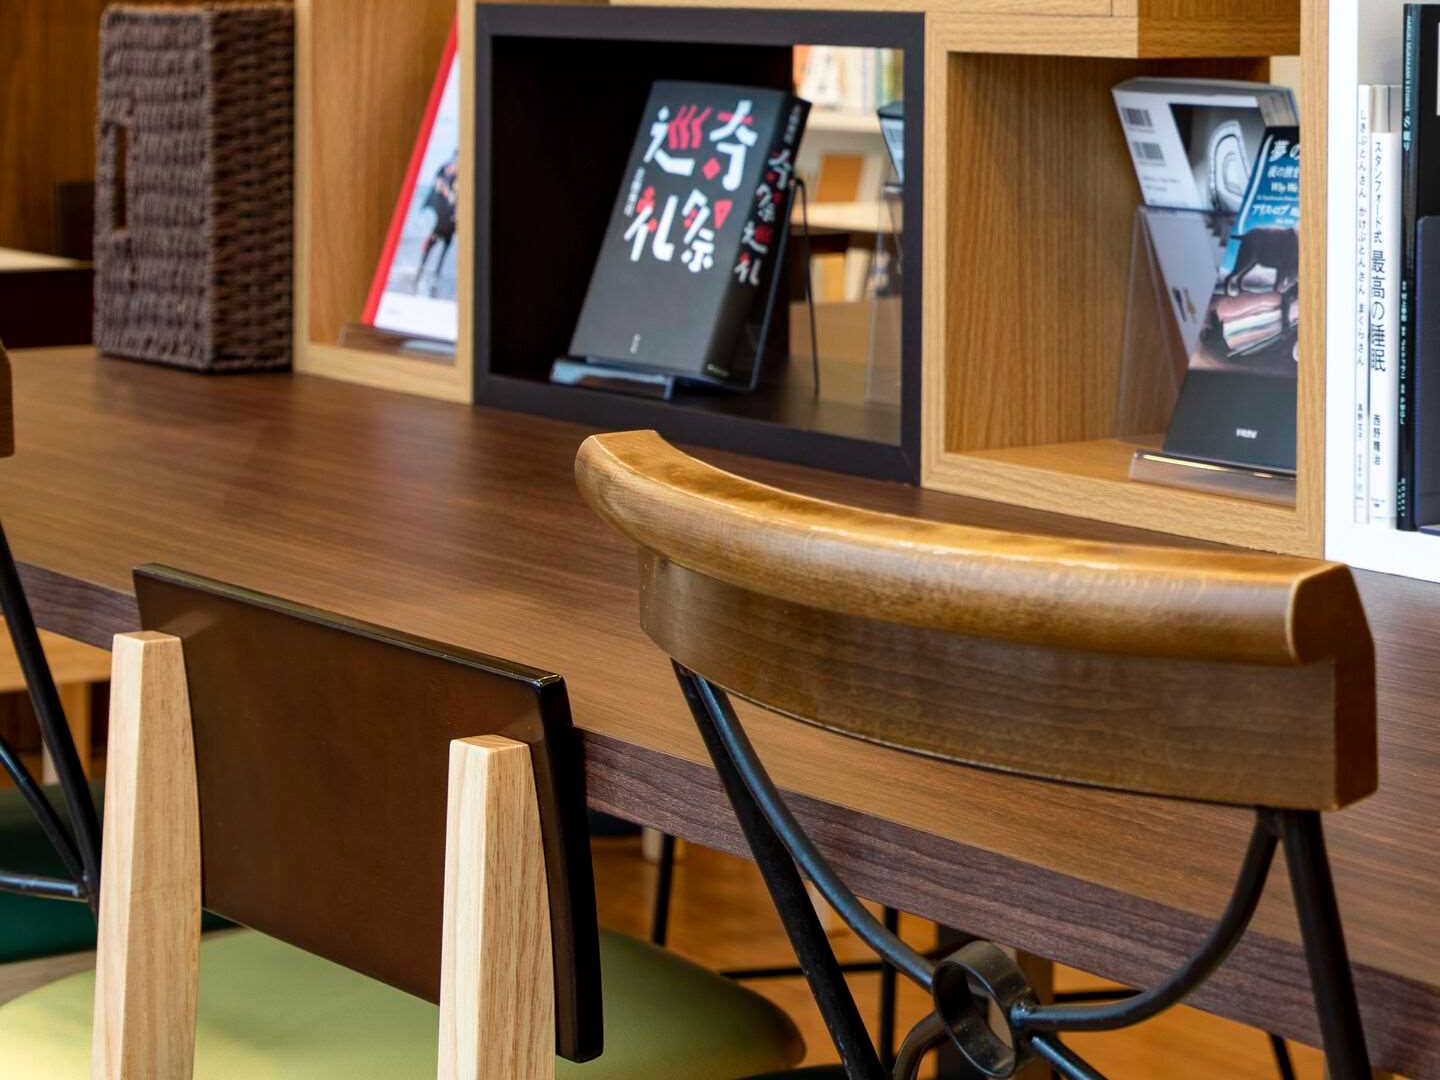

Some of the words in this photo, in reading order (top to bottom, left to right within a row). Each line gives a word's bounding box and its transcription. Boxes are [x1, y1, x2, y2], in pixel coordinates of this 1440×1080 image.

[1371, 249, 1387, 373] 最高の睡眠
